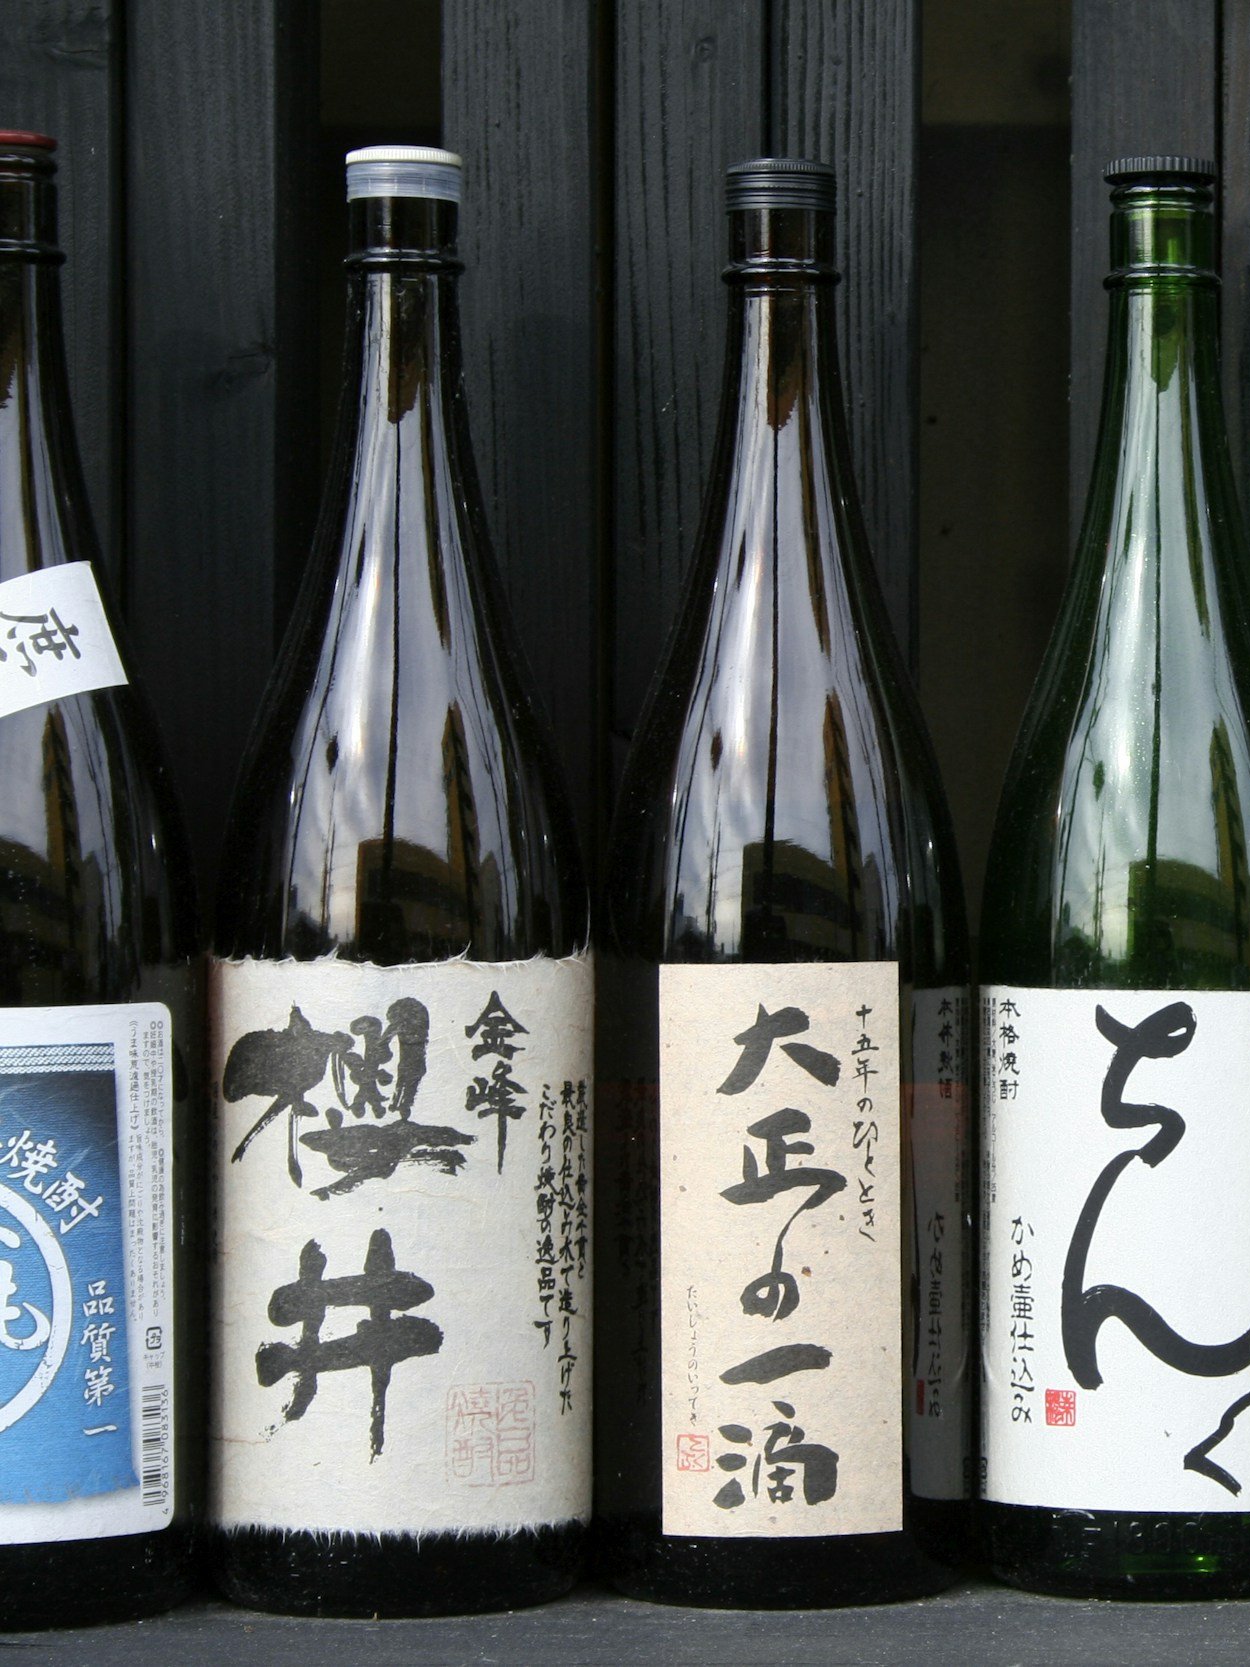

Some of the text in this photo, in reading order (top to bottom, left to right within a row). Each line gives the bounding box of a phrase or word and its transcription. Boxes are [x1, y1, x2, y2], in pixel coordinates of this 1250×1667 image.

[465, 990, 530, 1175] 金峰
[852, 1003, 880, 1243] 十五年のひととき
[0, 1130, 104, 1235] 焼酎
[712, 1003, 848, 1509] 大正の一滴
[80, 1279, 118, 1437] 品質第一
